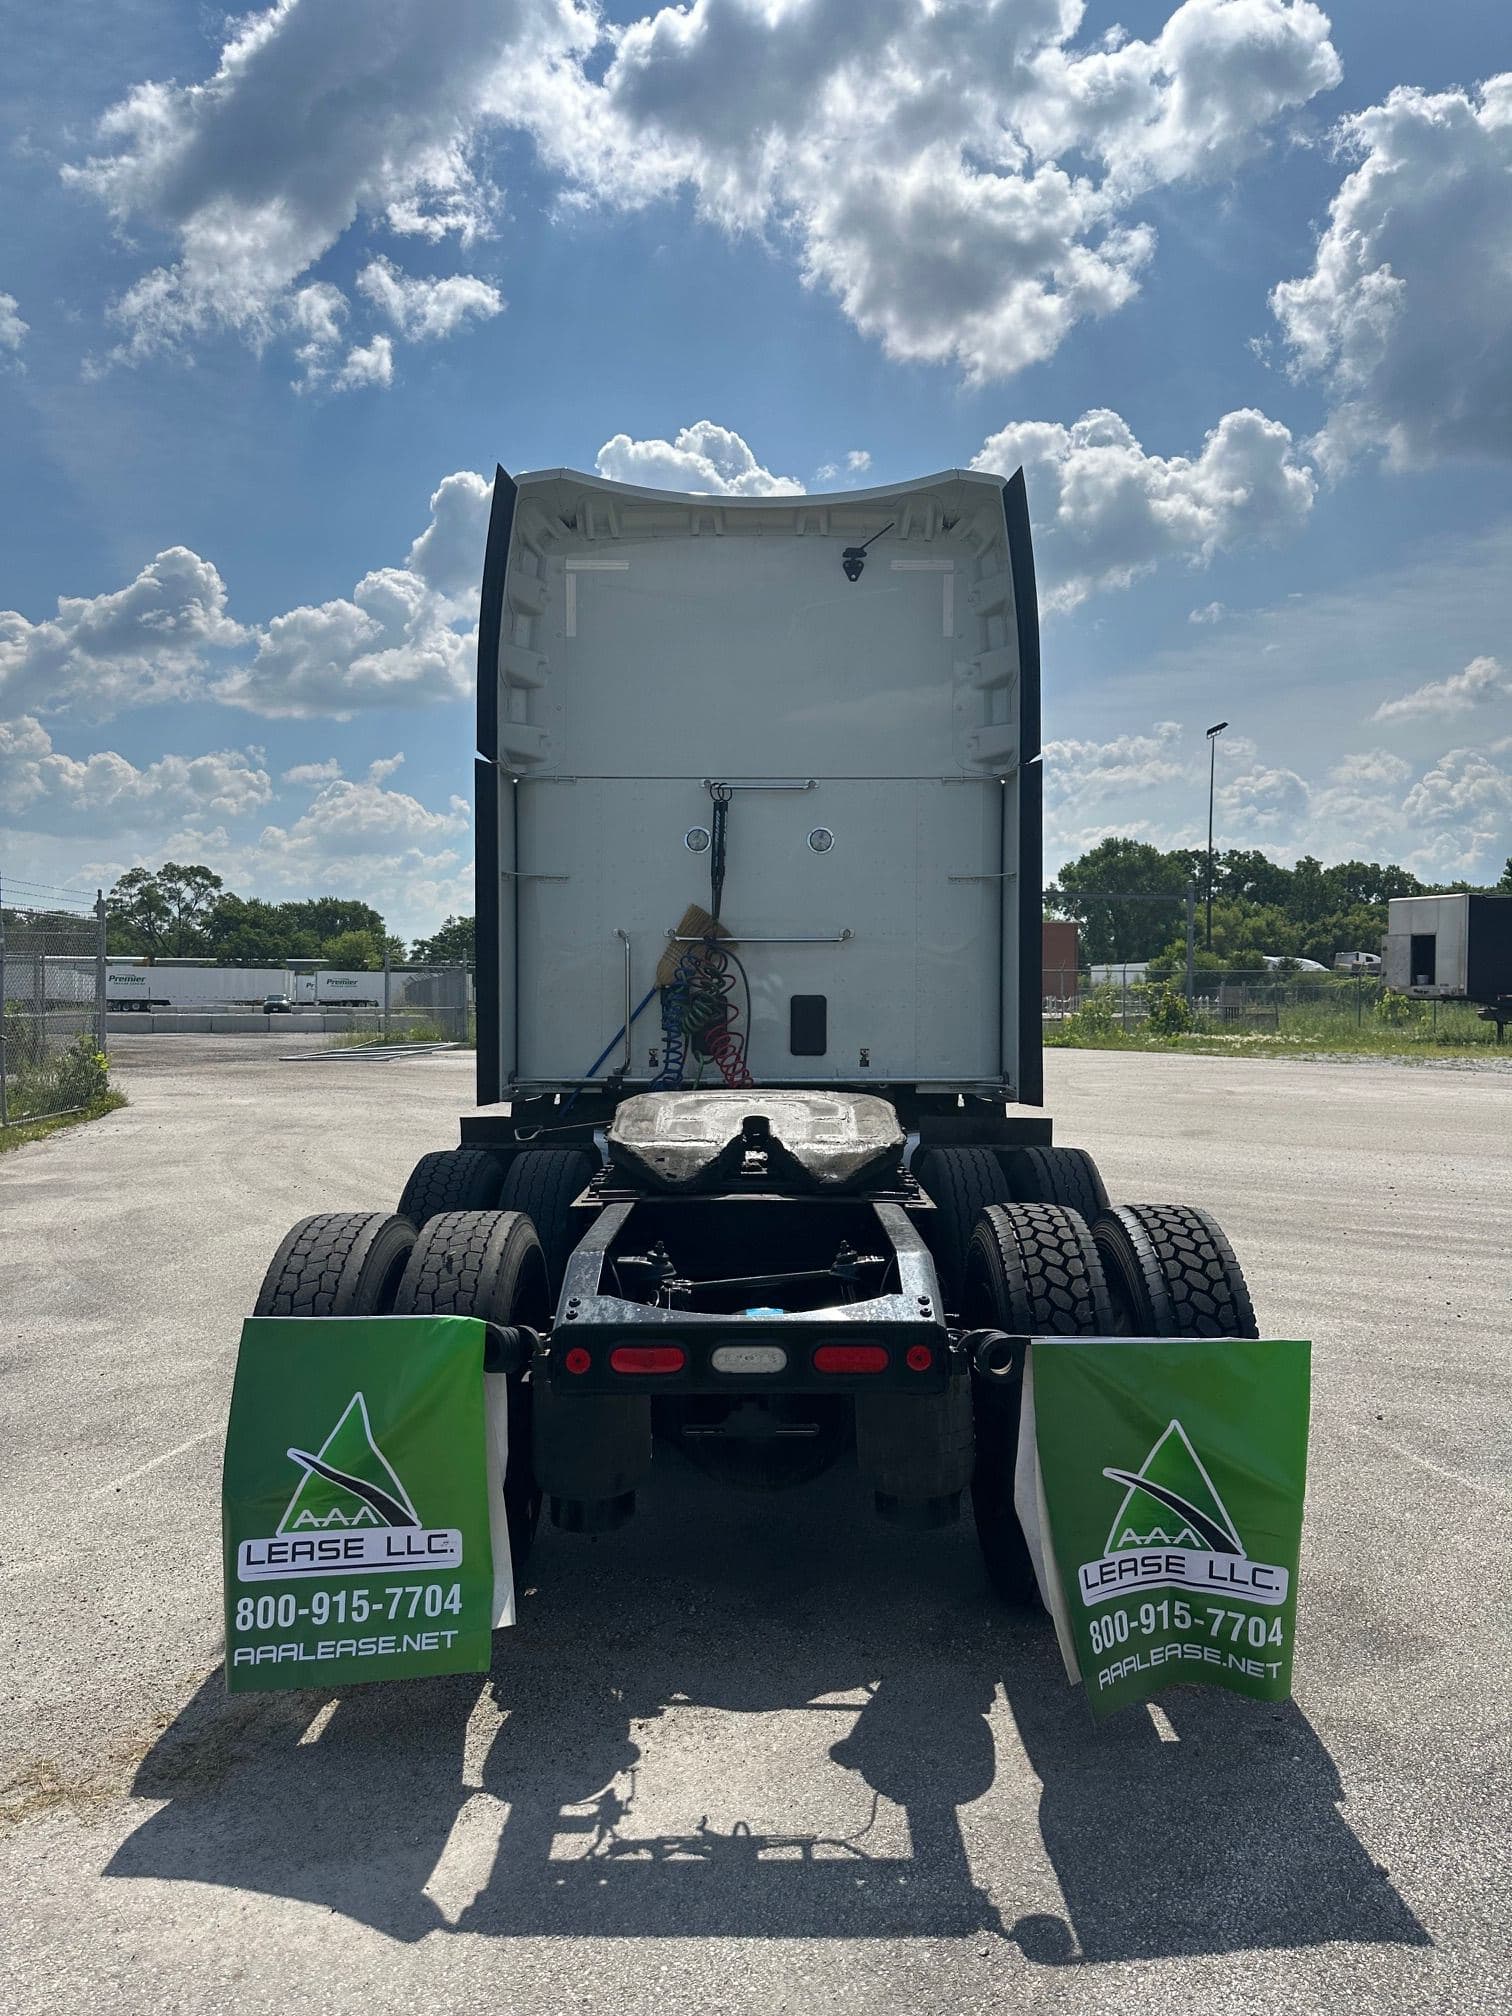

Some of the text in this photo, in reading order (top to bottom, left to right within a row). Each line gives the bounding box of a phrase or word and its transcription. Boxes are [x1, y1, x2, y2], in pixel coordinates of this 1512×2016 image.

[108, 974, 146, 983] Premier
[291, 1506, 379, 1529] AAA
[246, 1533, 455, 1566] LEASE LLC.
[1117, 1527, 1201, 1548] AAA
[1083, 1555, 1280, 1591] LEASE LLC.
[235, 1583, 462, 1631] 800-915-7704
[1089, 1600, 1284, 1655] 800-915-7704
[233, 1630, 459, 1667] AAALEASE.NET
[1099, 1643, 1283, 1691] AAALEASE.NET
